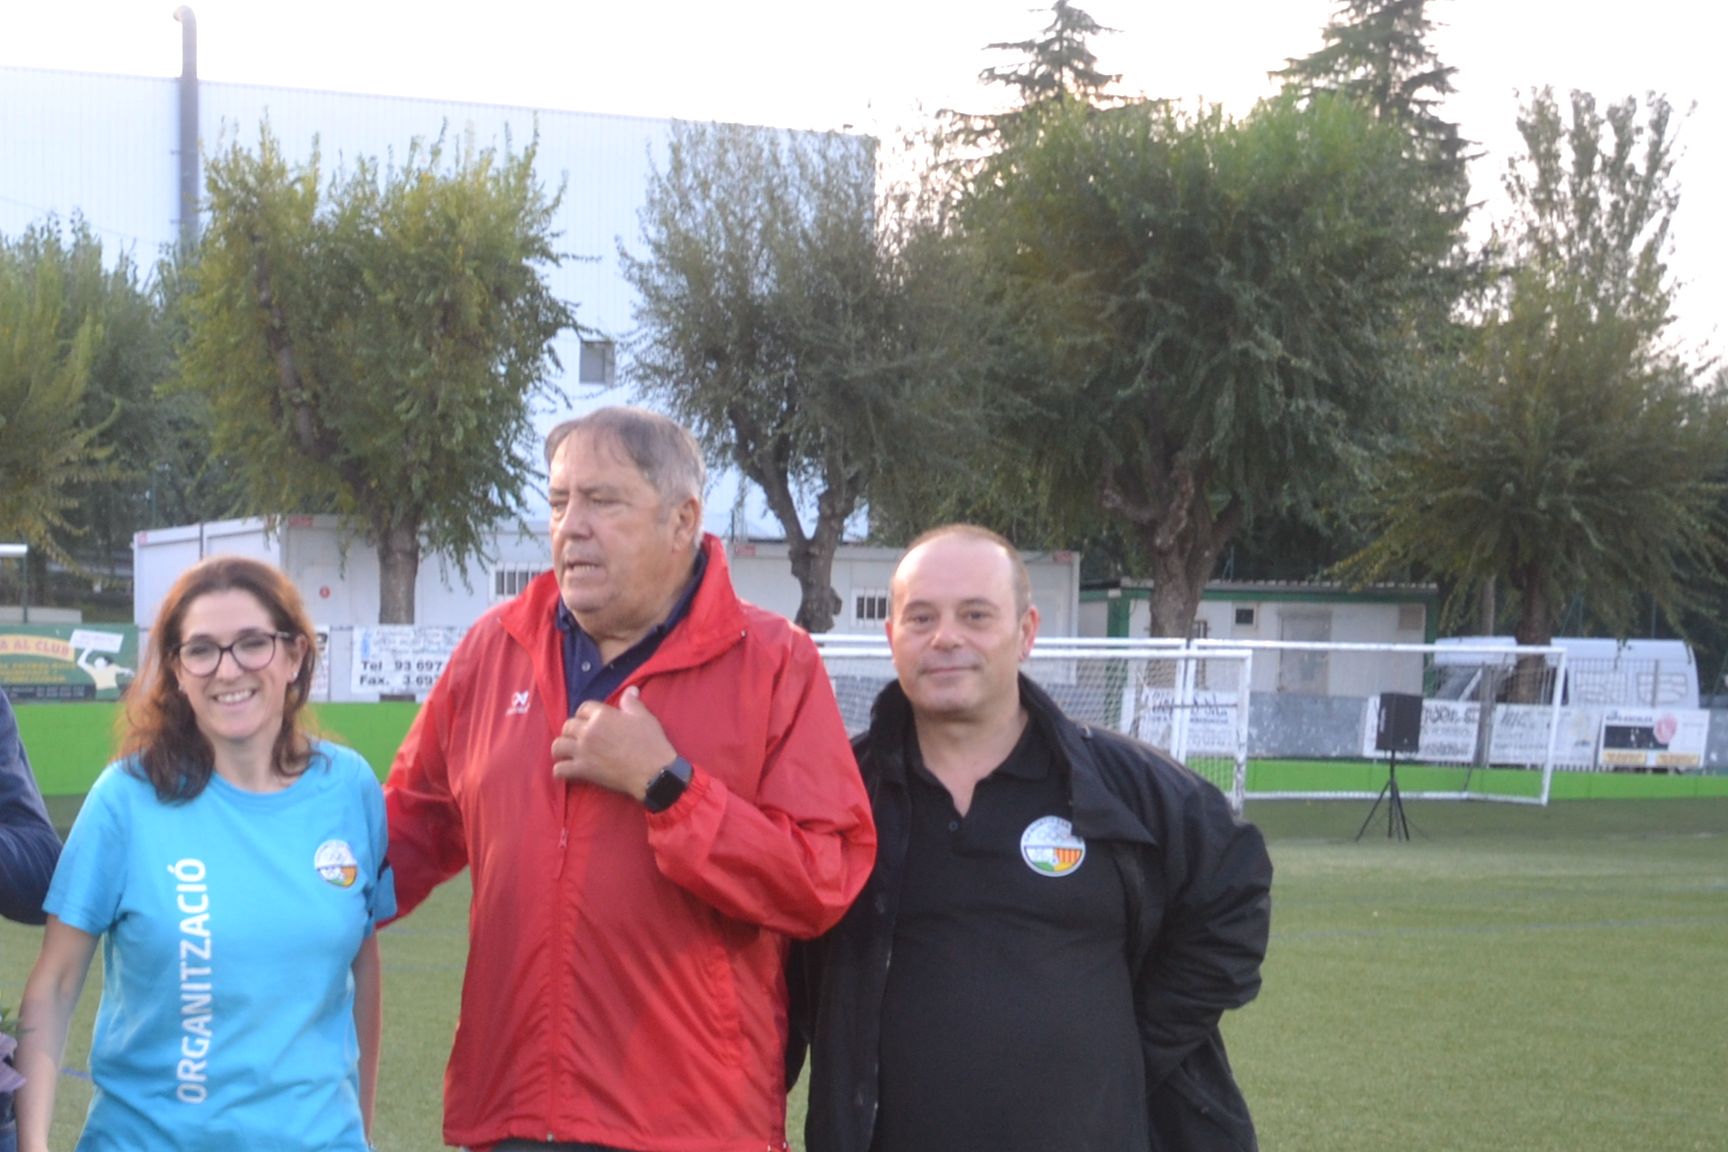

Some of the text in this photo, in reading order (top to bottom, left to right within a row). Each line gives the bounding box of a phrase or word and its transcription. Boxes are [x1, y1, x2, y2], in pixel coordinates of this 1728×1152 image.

[394, 660, 412, 671] 93
[416, 675, 440, 687] 69
[167, 858, 214, 1105] ORGANITZACIÓ
